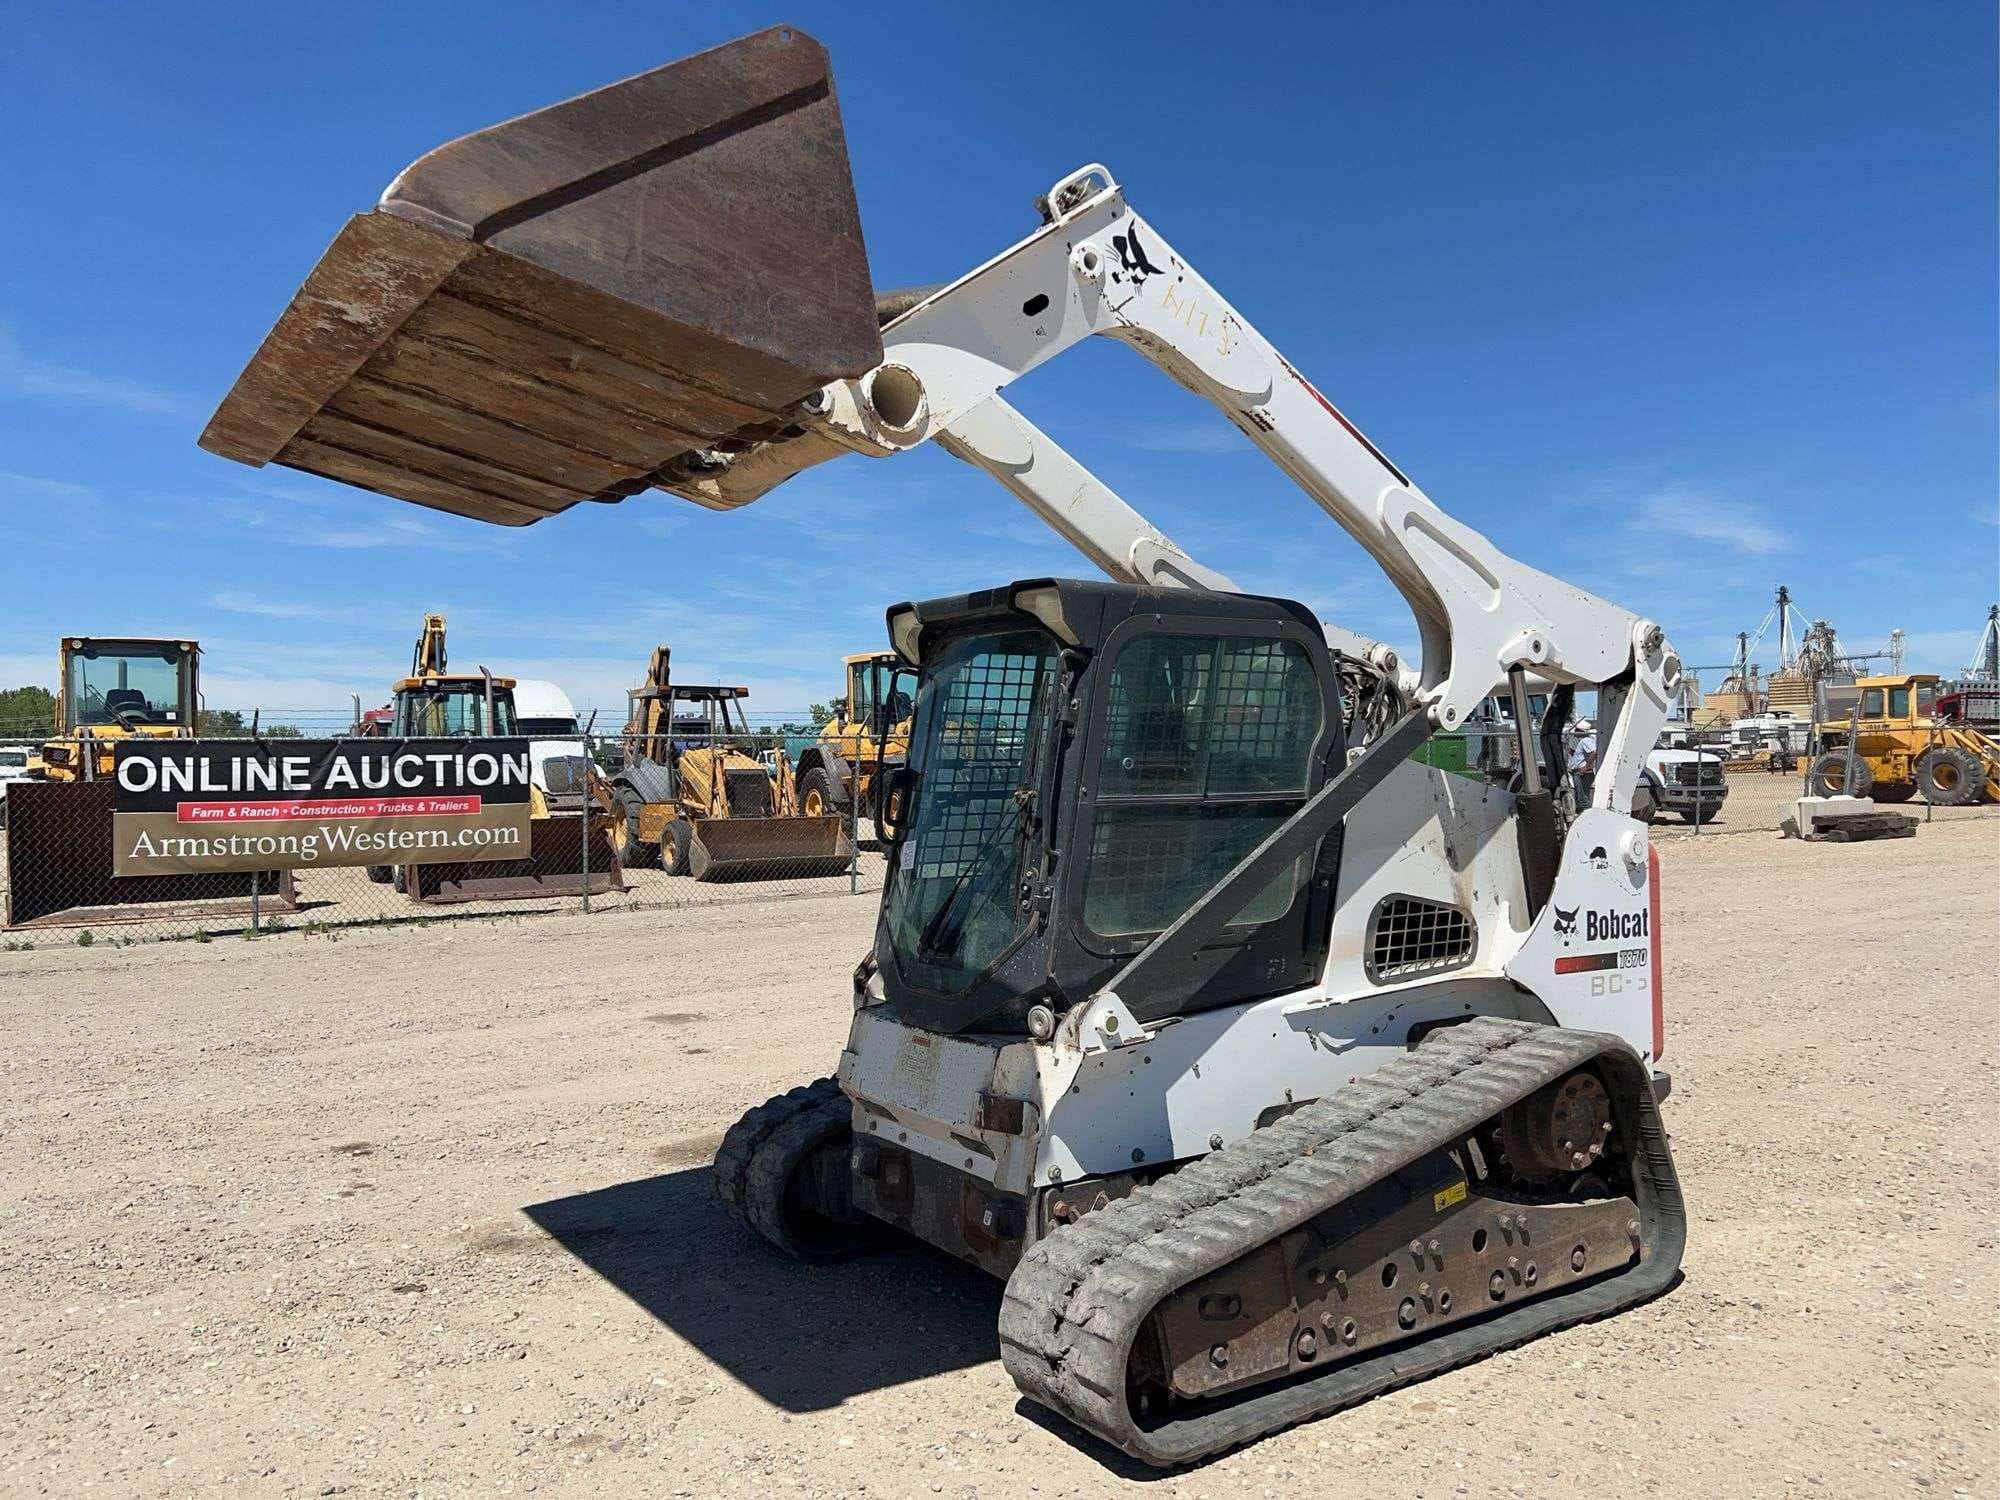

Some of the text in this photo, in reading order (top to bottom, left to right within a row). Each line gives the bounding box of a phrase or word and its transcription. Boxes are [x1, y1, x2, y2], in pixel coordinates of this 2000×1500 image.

[118, 753, 528, 792] ONLINE AUCTION
[191, 801, 469, 818] Farm & Ranch Construction Trucks & Trailers
[129, 825, 520, 861] ArmstrongWestern.com
[1586, 907, 1648, 941] Bobcat
[1619, 948, 1647, 969] T870
